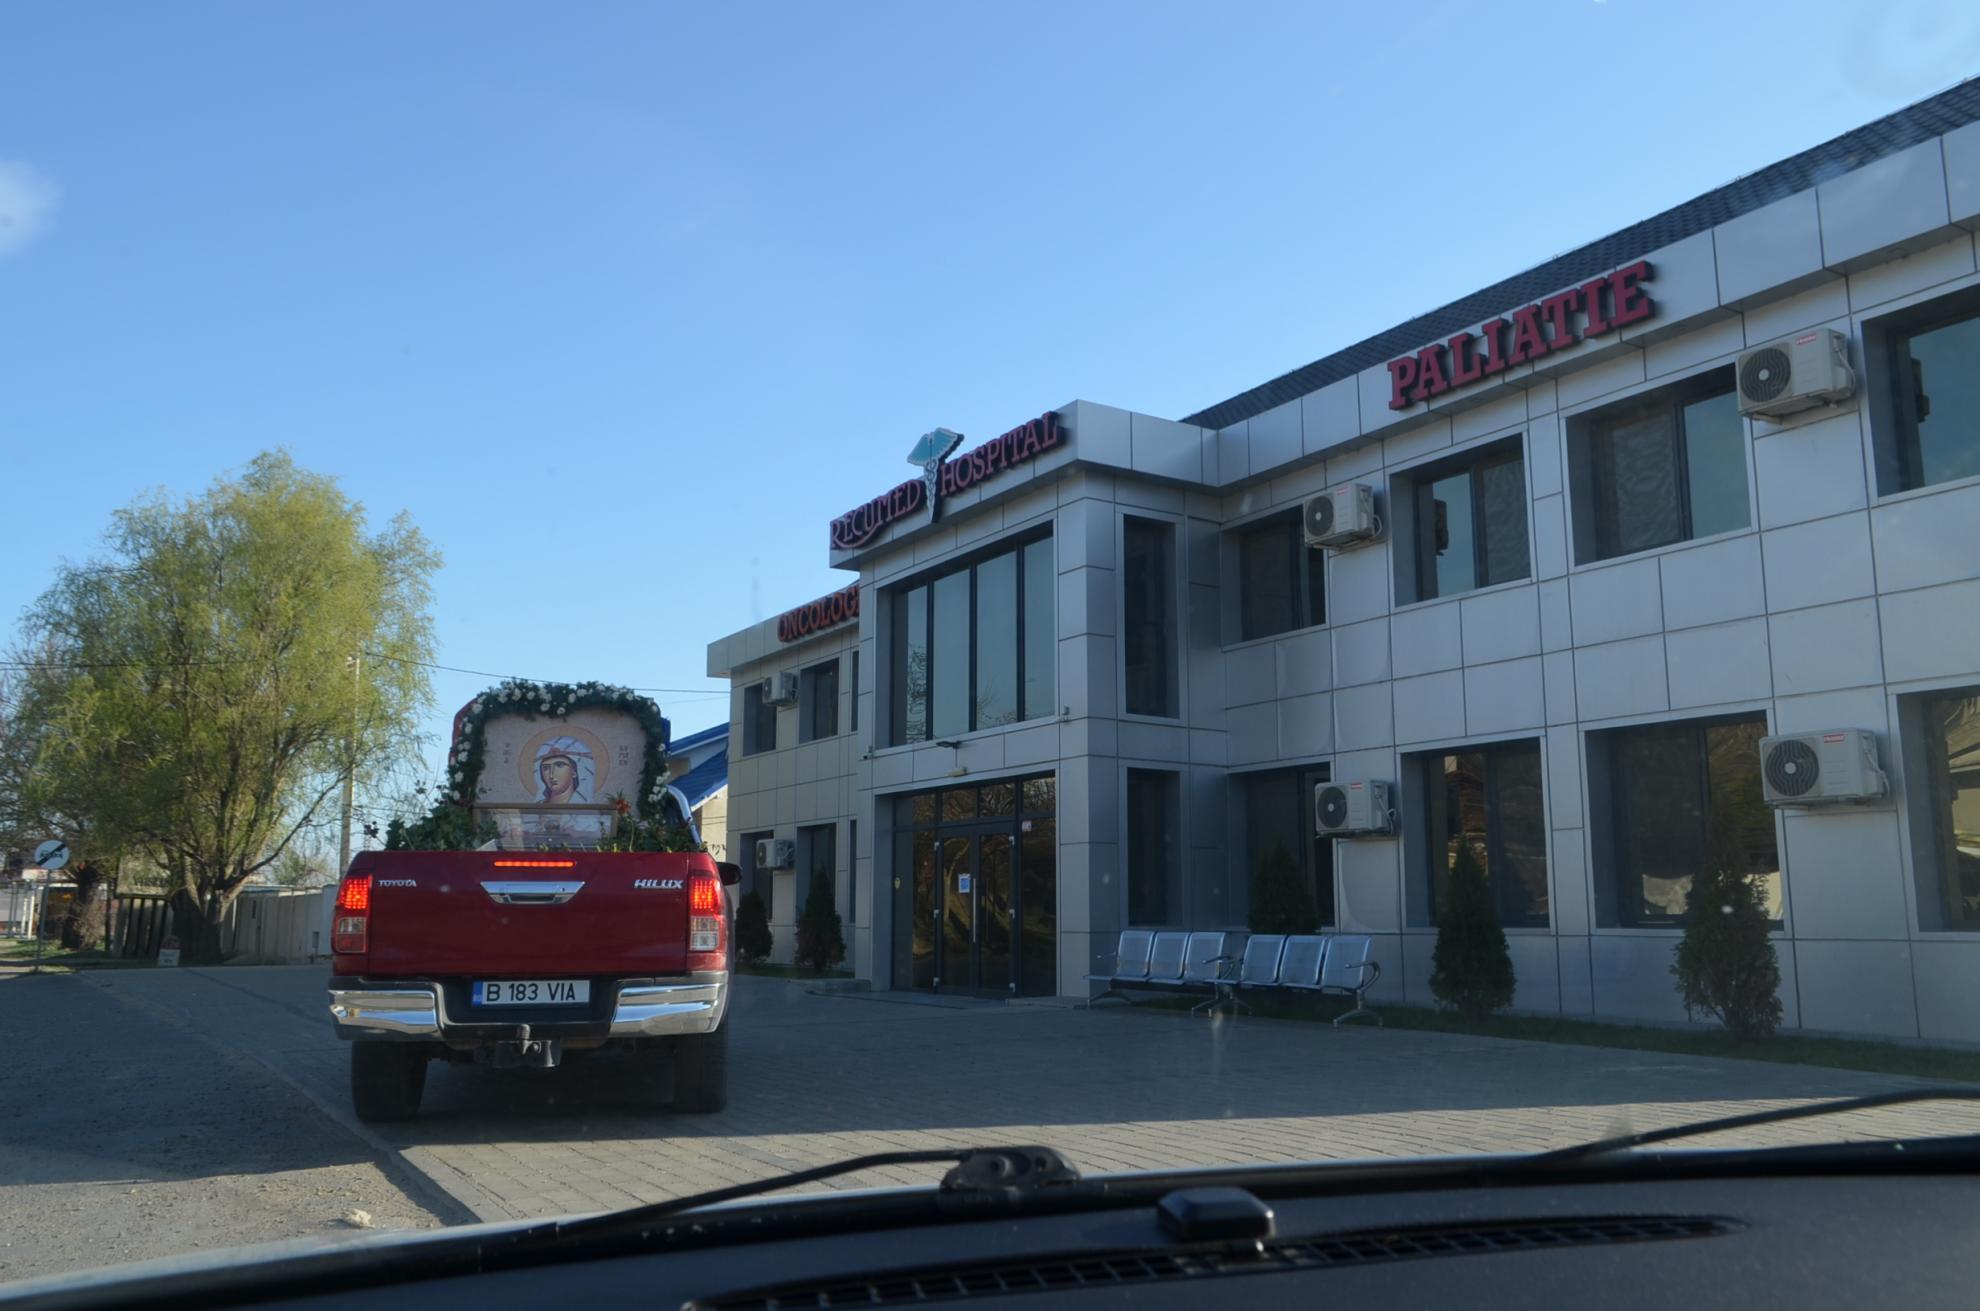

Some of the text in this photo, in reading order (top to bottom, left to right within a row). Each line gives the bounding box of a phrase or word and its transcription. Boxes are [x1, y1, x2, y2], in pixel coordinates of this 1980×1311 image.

[1387, 260, 1653, 410] PALIATIE
[830, 411, 1058, 549] RECUMED HOSPITAL
[378, 879, 417, 887] TOYOTA
[634, 879, 683, 889] HILUX
[486, 983, 501, 1002] B
[508, 983, 539, 1001] 183
[547, 982, 576, 1001] VIA
